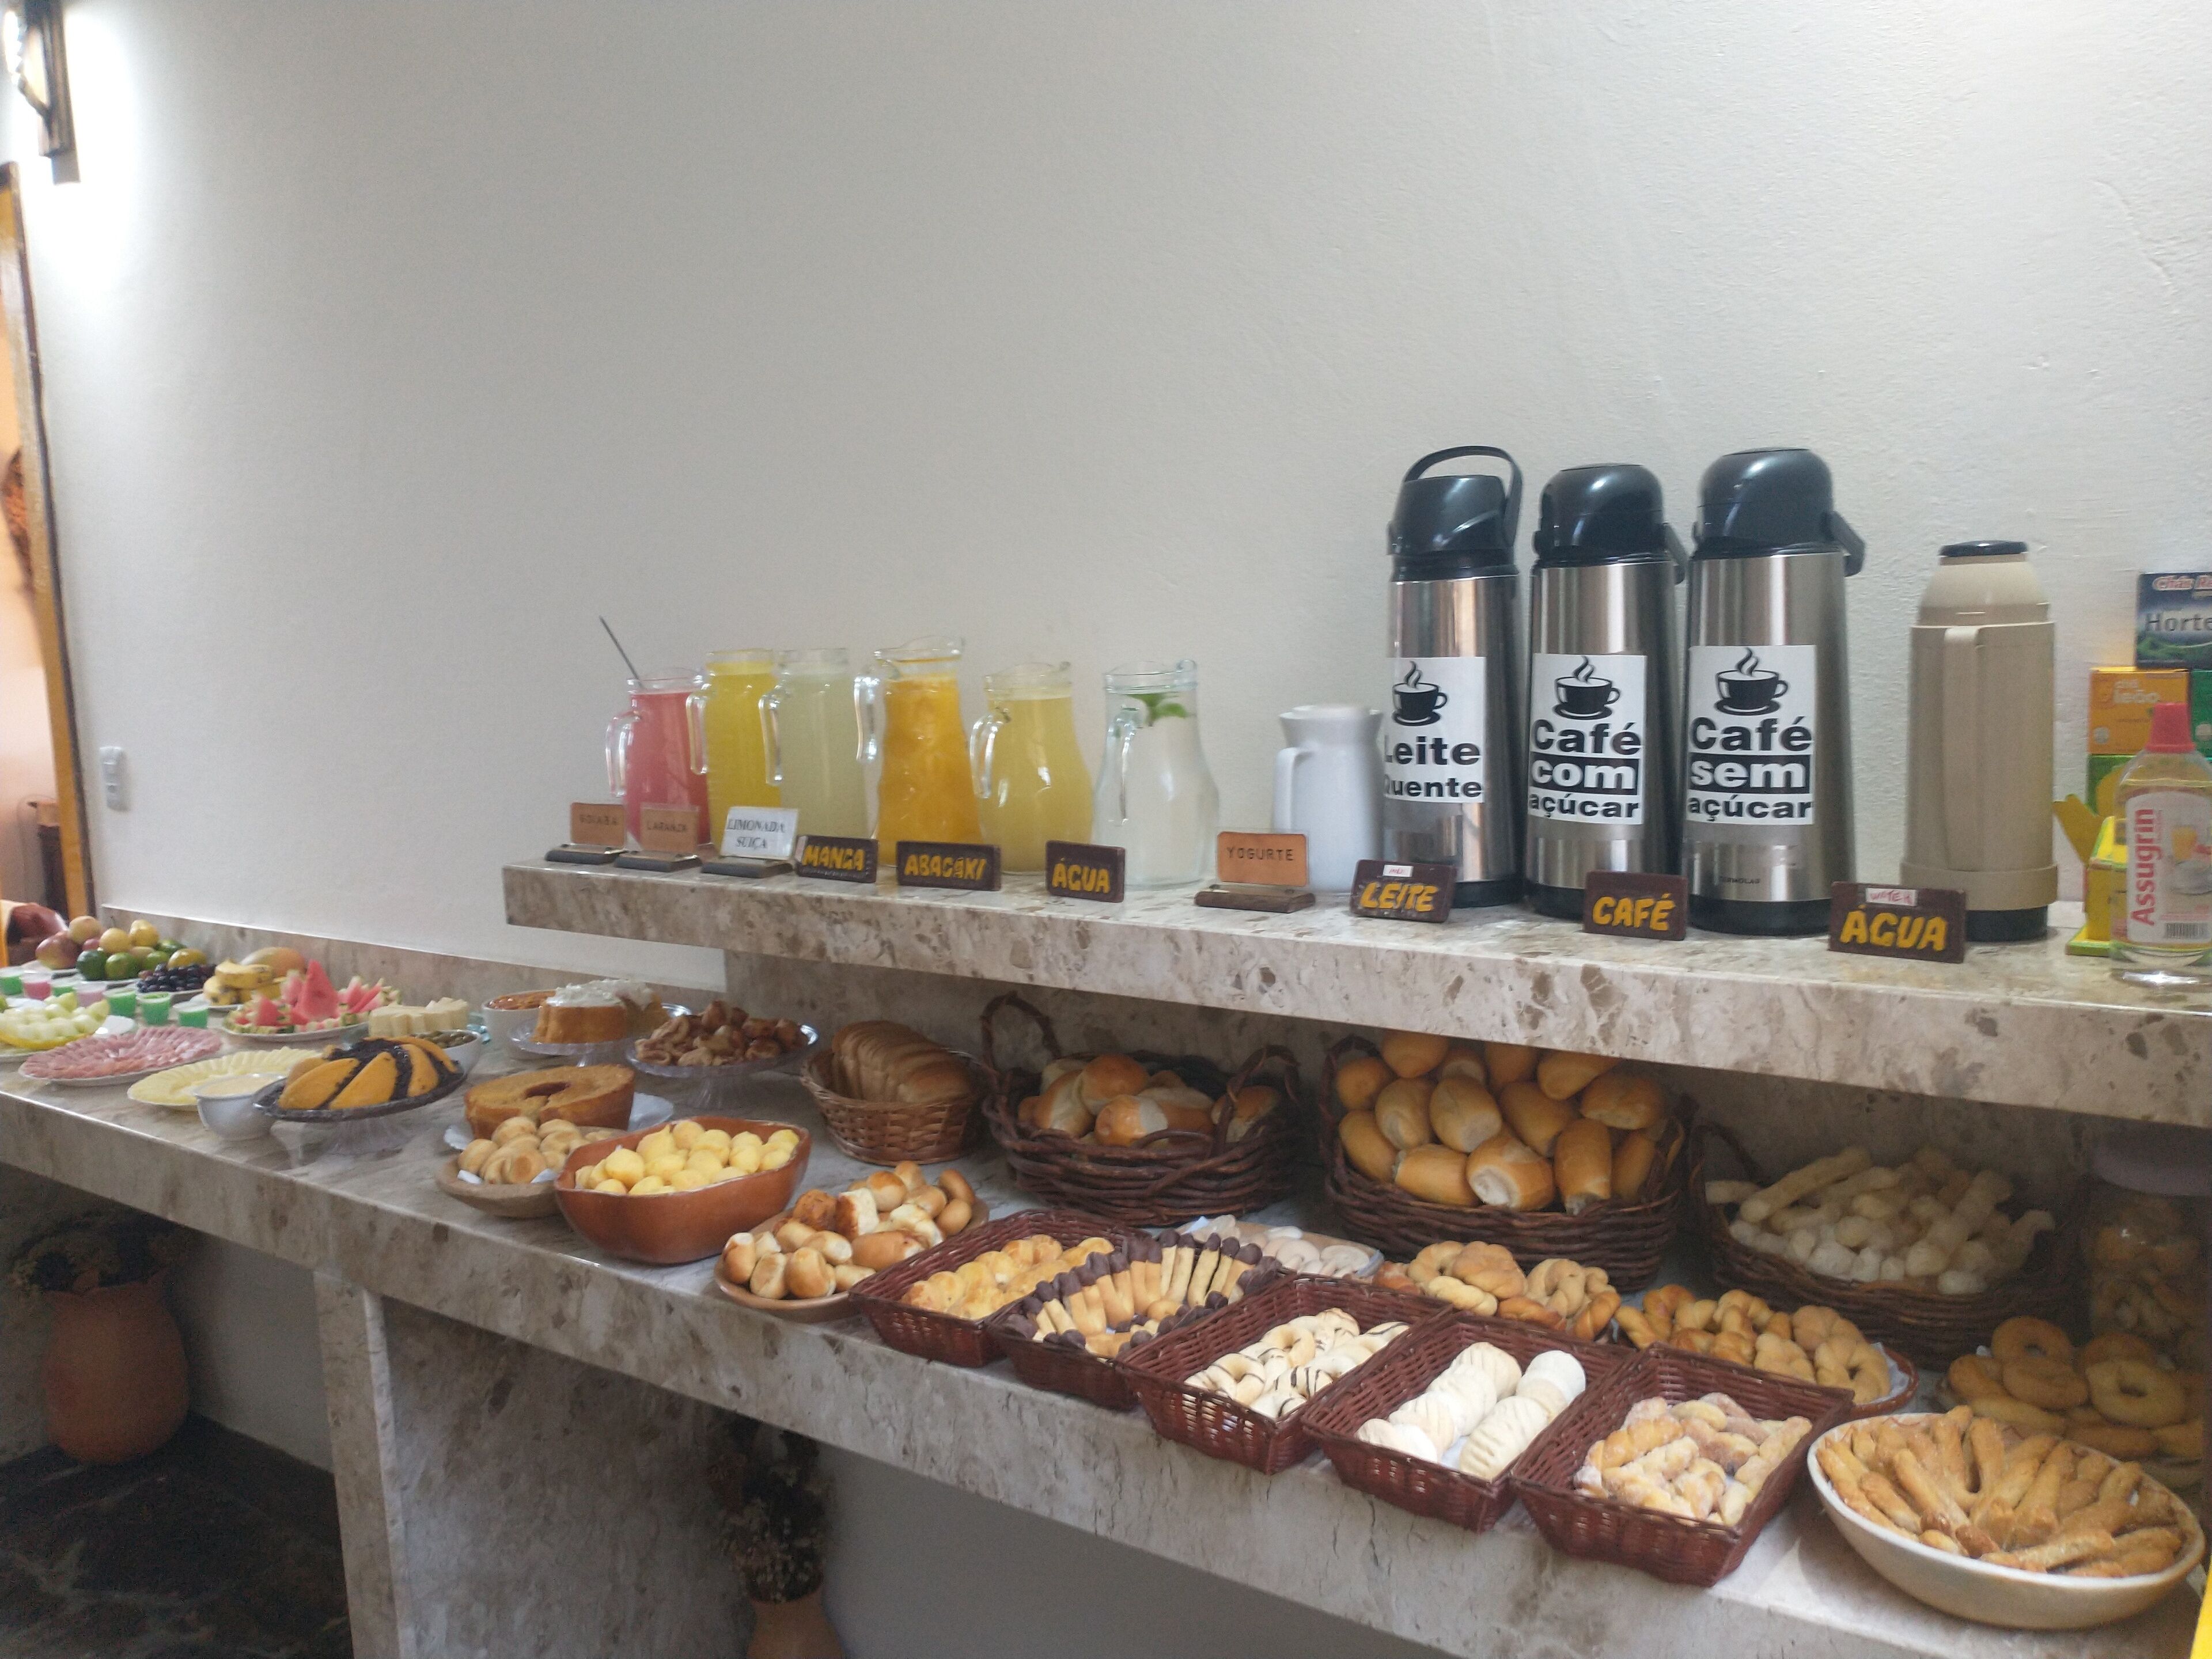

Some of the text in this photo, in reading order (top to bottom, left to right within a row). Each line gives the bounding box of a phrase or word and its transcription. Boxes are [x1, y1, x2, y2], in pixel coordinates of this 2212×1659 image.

[1533, 719, 1642, 755] Café
[1690, 716, 1812, 752] Café
[1532, 759, 1637, 790] com
[1690, 760, 1805, 789] sem
[1529, 793, 1640, 819] açúcar
[1687, 794, 1813, 821] açúcar
[727, 819, 785, 832] LIMONADA
[802, 845, 863, 872] MANGA
[904, 854, 987, 881] ABACAXI
[1227, 846, 1294, 862] YOGURTE
[2130, 808, 2161, 926] Assugrin
[1052, 857, 1110, 893] ÁGUA
[1360, 881, 1438, 912] LEITE
[1592, 893, 1675, 931] CAFÉ
[1840, 904, 1948, 951] ÁGUA
